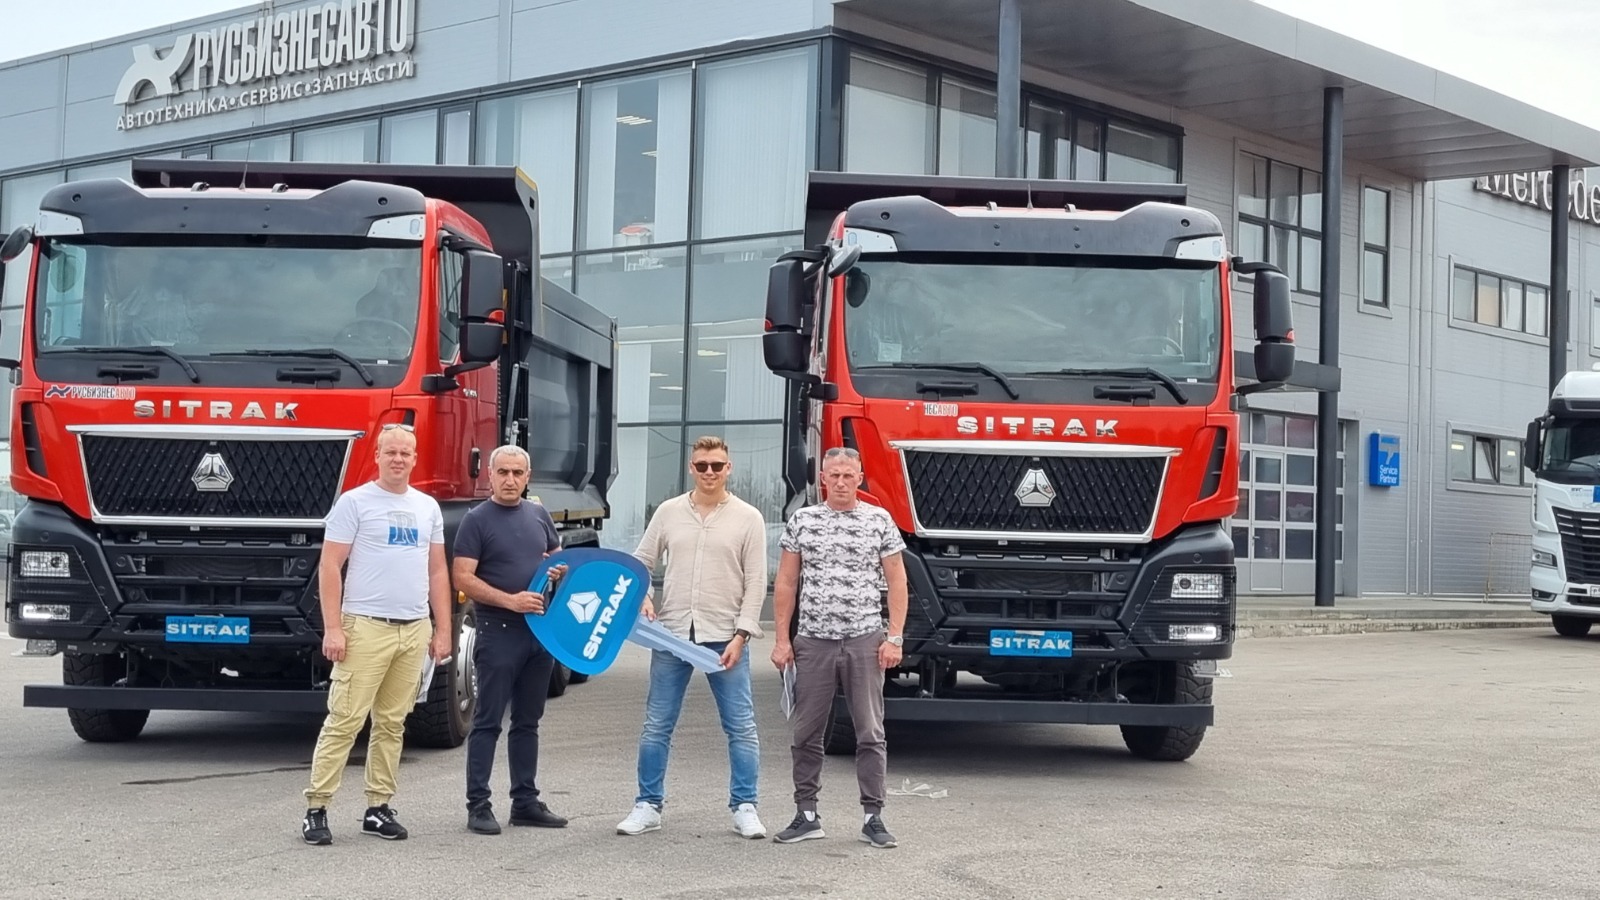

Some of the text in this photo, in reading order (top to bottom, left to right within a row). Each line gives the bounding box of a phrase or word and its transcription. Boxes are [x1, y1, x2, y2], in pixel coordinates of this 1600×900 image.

[193, 0, 410, 91] РУСБИЗНЕСАВТО
[116, 60, 414, 131] АВТОТЕХНИКА СЕРВИС ЗАПЧАСТИ
[72, 386, 135, 399] РУСБИЗНЕСАВТО
[133, 400, 299, 421] SITRAK
[957, 416, 1121, 438] SITRAK
[1379, 464, 1398, 475] Service
[1379, 473, 1398, 484] Partner
[582, 574, 633, 660] SITRAK
[166, 623, 249, 636] SITRAK
[991, 637, 1072, 650] SITRAK
